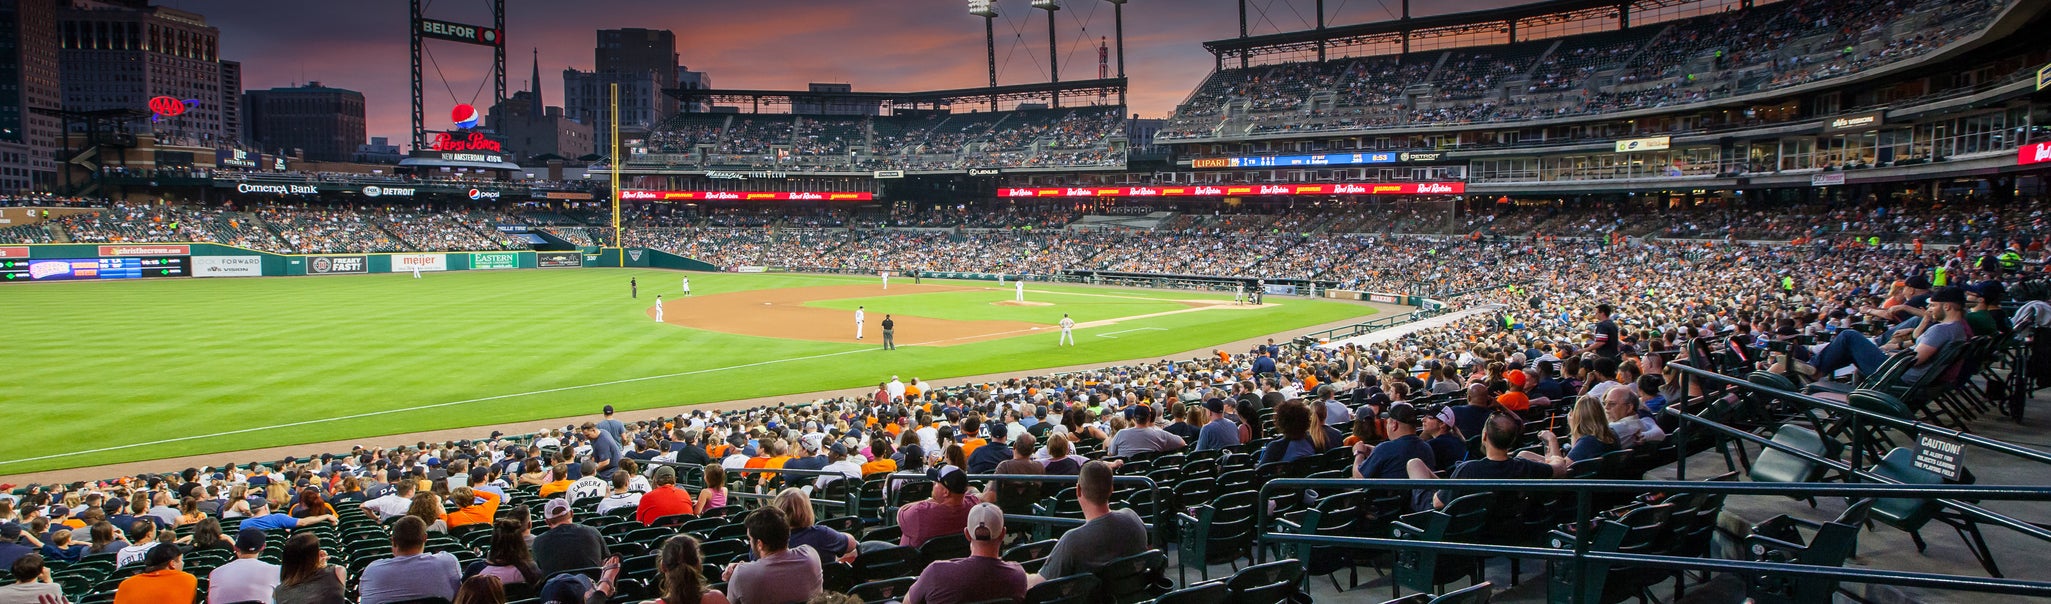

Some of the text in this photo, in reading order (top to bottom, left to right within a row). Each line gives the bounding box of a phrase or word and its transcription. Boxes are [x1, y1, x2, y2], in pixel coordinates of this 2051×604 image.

[423, 21, 475, 39] BELFOR
[151, 98, 182, 115] AAA
[233, 148, 247, 160] Lite
[454, 153, 485, 161] AMSTERDAM
[1197, 159, 1225, 167] LIPARI
[290, 185, 318, 193] Bank
[383, 187, 415, 195] DETROIT
[1009, 188, 1019, 196] Red
[1019, 188, 1033, 196] Robin
[1067, 188, 1077, 196] Red
[1077, 188, 1092, 196] Robin
[1129, 187, 1140, 195] Red
[1140, 187, 1156, 195] Robin
[1194, 187, 1205, 195] Red
[1205, 187, 1221, 195] Robin
[1260, 185, 1272, 194] Red
[1272, 185, 1289, 194] Robin
[1334, 184, 1346, 193] Red
[1346, 184, 1366, 193] Robin
[1417, 184, 1431, 193] Red
[1431, 183, 1452, 193] Robin
[480, 191, 500, 199] pepsi
[622, 191, 636, 199] Red
[636, 191, 656, 199] Robin
[705, 191, 719, 199] Red
[719, 191, 739, 199] Robin
[27, 209, 36, 217] 42
[403, 254, 436, 266] meijer
[332, 263, 361, 271] FAST!
[1922, 437, 1960, 454] CAUTION!
[1917, 455, 1936, 464] OBJECTS
[1930, 452, 1944, 460] ALERT
[1922, 464, 1942, 474] PLAYING
[572, 480, 601, 493] CABRERA
